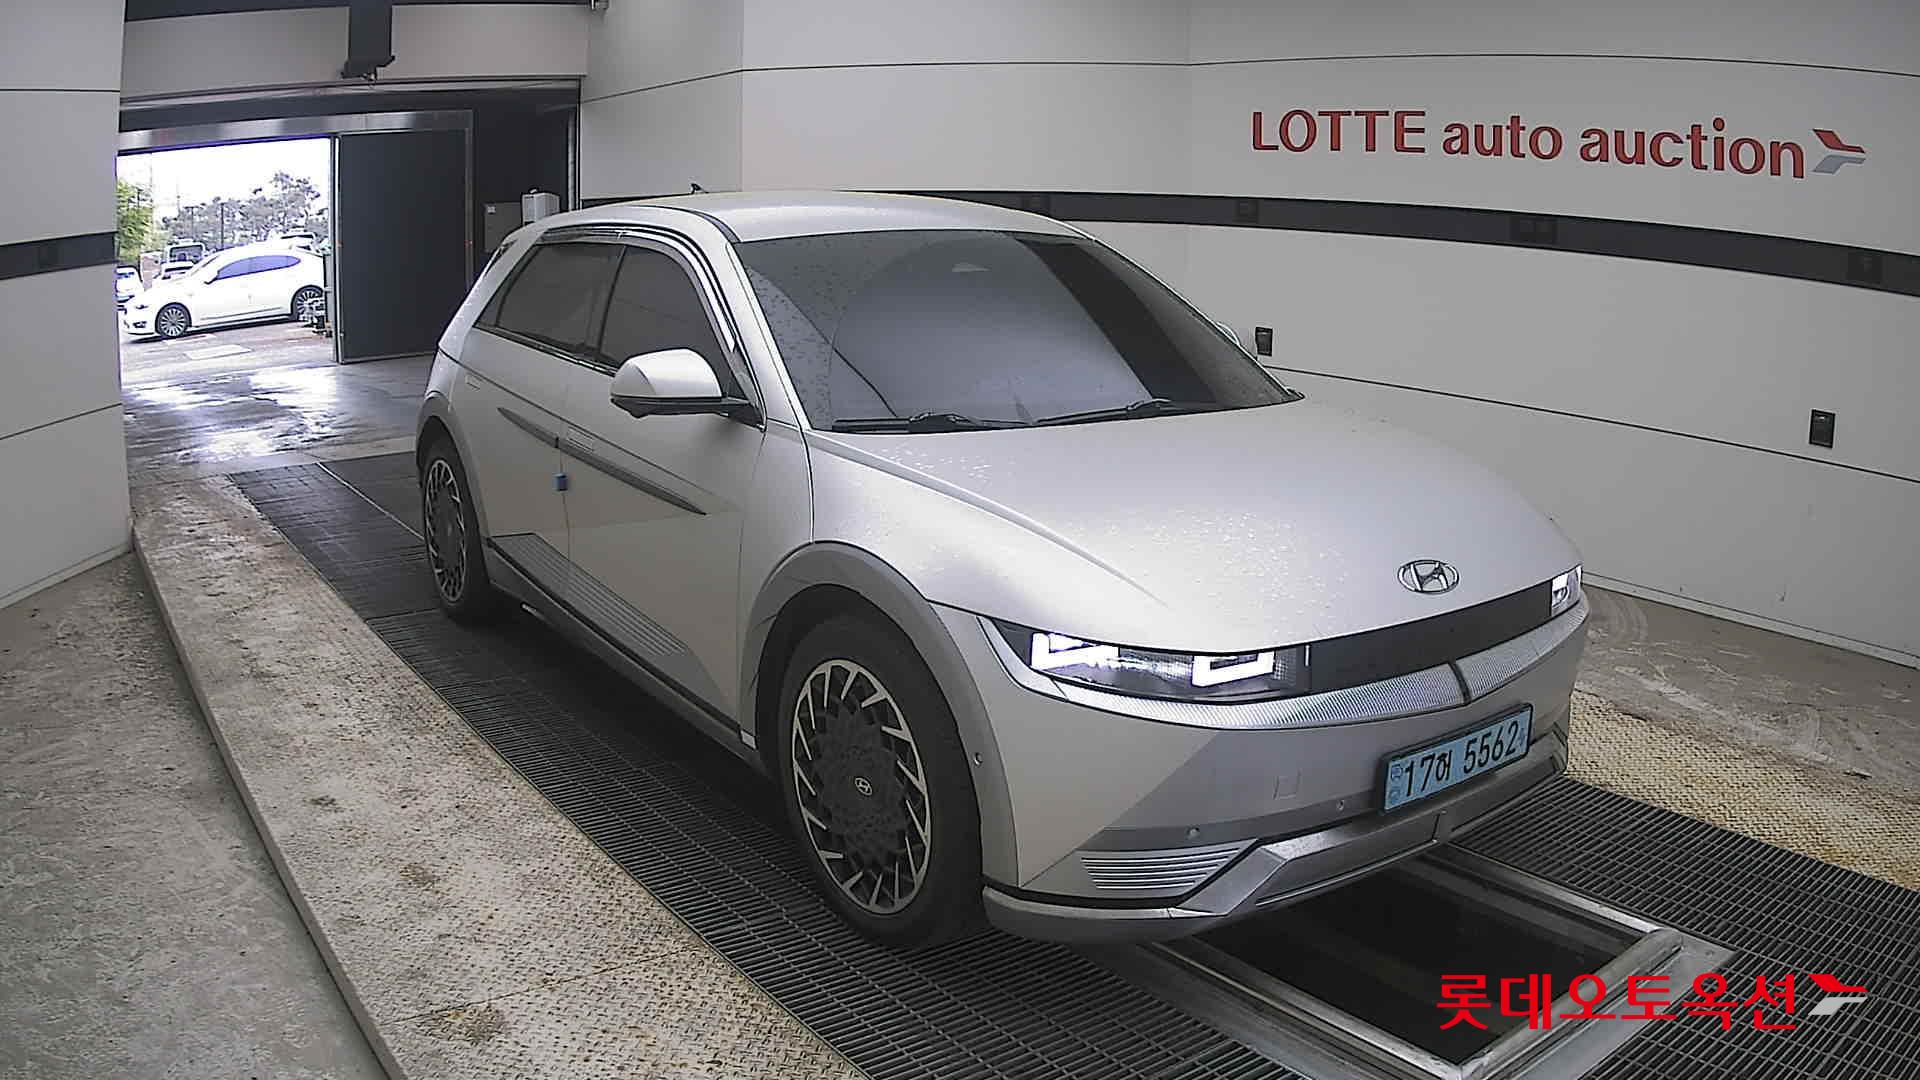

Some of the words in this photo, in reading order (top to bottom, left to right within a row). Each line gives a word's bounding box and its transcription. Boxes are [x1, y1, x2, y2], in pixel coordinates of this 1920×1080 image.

[1252, 110, 1426, 153] LOTTE
[1443, 115, 1563, 160] auto
[1579, 117, 1805, 179] auction
[1404, 750, 1453, 797] 17허
[1463, 720, 1519, 774] 5562
